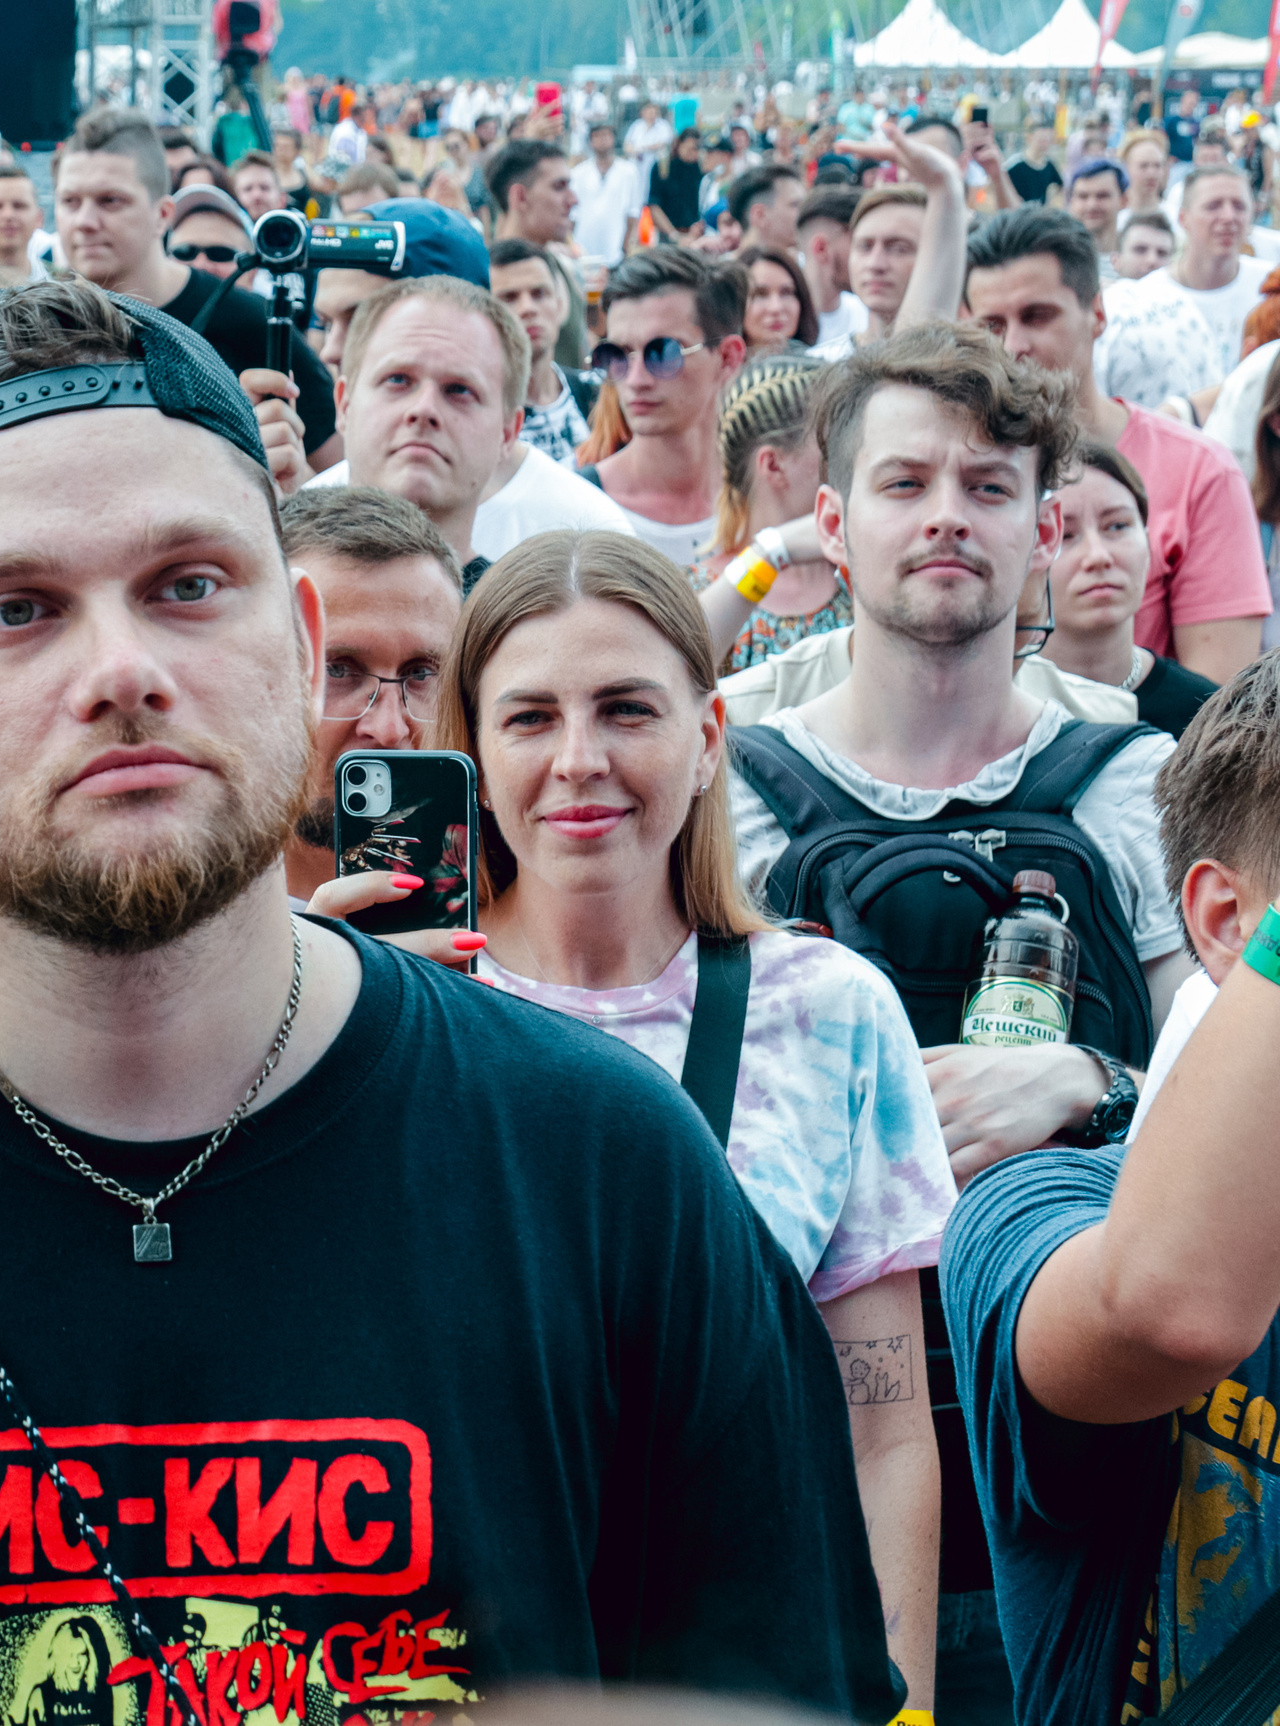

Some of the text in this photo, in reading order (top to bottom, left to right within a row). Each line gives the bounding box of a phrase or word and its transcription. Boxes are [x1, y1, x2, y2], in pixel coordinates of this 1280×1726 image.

[972, 1017, 1057, 1042] Чешский
[994, 1035, 1032, 1046] рецепт
[322, 1608, 470, 1703] СЕБЕ
